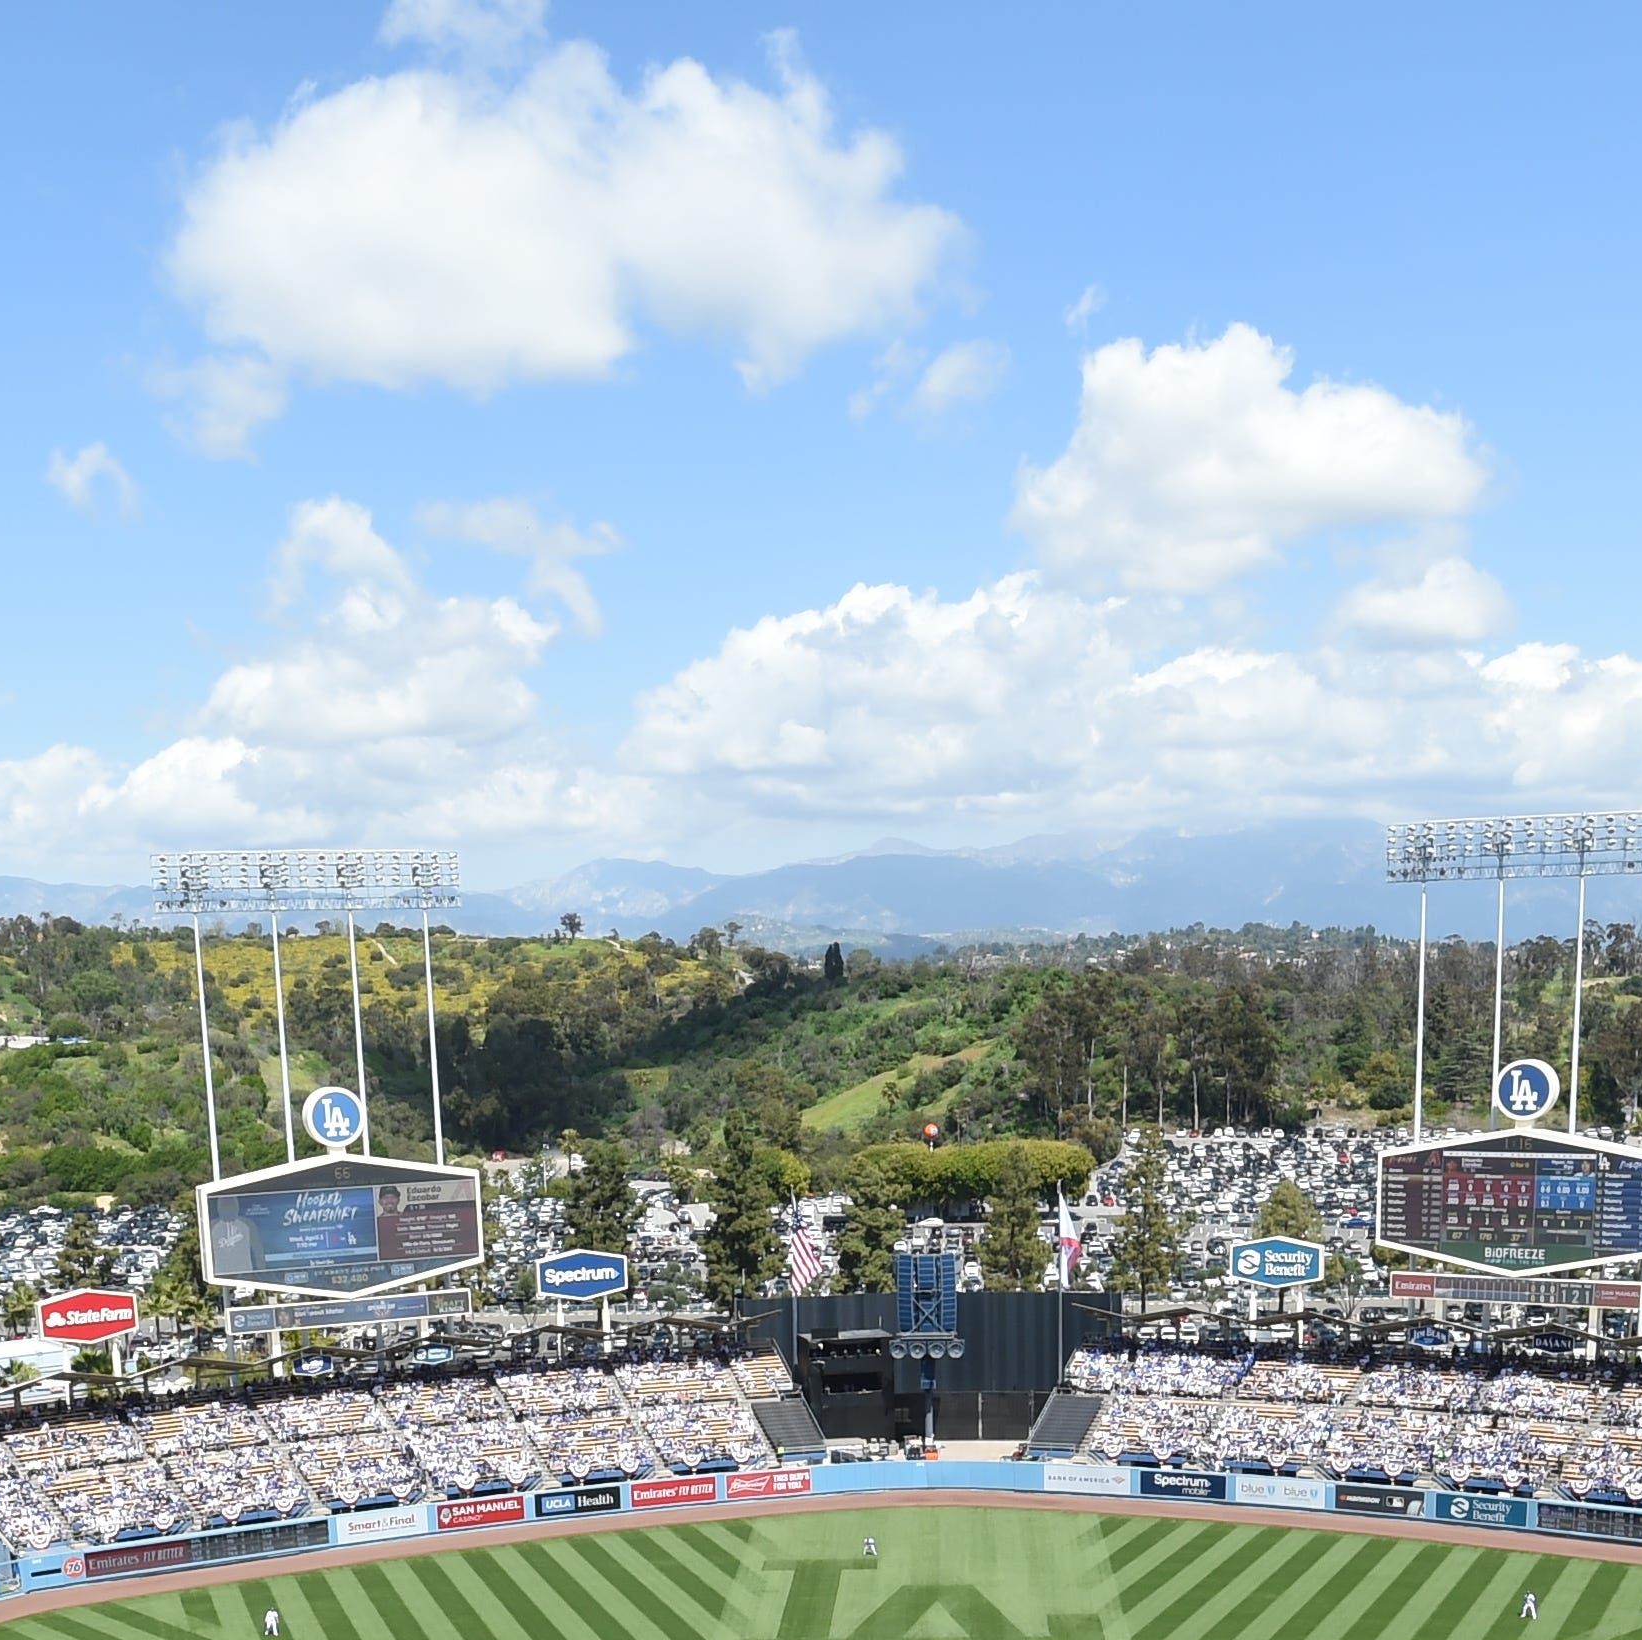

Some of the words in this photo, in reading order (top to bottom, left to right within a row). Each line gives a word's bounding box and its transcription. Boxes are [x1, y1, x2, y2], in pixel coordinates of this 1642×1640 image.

[1510, 1070, 1538, 1111] LA
[321, 1098, 350, 1138] LA
[406, 1184, 442, 1195] Eduardo
[296, 1191, 342, 1208] HOODED
[406, 1193, 440, 1202] Escobar
[283, 1207, 358, 1227] SWEATSHIRT
[1263, 1249, 1314, 1268] Security
[544, 1263, 616, 1286] Spectrum
[1264, 1262, 1308, 1277] Benefit
[1394, 1280, 1432, 1292] Emirates
[1413, 1329, 1427, 1342] JIM
[1426, 1327, 1448, 1343] BEAM
[1535, 1337, 1573, 1349] DASANI
[773, 1474, 786, 1483] THIS
[773, 1482, 786, 1490] FOR
[1078, 1476, 1110, 1484] AMERICA
[1154, 1473, 1209, 1489] Spectrum
[633, 1488, 679, 1501] Emirates
[679, 1486, 690, 1497] FLY
[691, 1483, 713, 1496] BETTER
[1181, 1486, 1207, 1496] mobile
[1241, 1482, 1265, 1495] blue
[1283, 1485, 1308, 1498] blue
[452, 1504, 475, 1516] SAN
[476, 1500, 521, 1513] MANUEL
[545, 1499, 572, 1510] UCLA
[577, 1492, 614, 1508] Health
[1472, 1499, 1512, 1513] Security
[348, 1519, 380, 1532] Smart
[389, 1513, 416, 1527] Final
[1472, 1509, 1506, 1523] Benefit
[88, 1554, 140, 1571] Emirates
[142, 1549, 156, 1563] FLY
[157, 1545, 184, 1562] BETTER
[65, 1560, 82, 1574] 76
